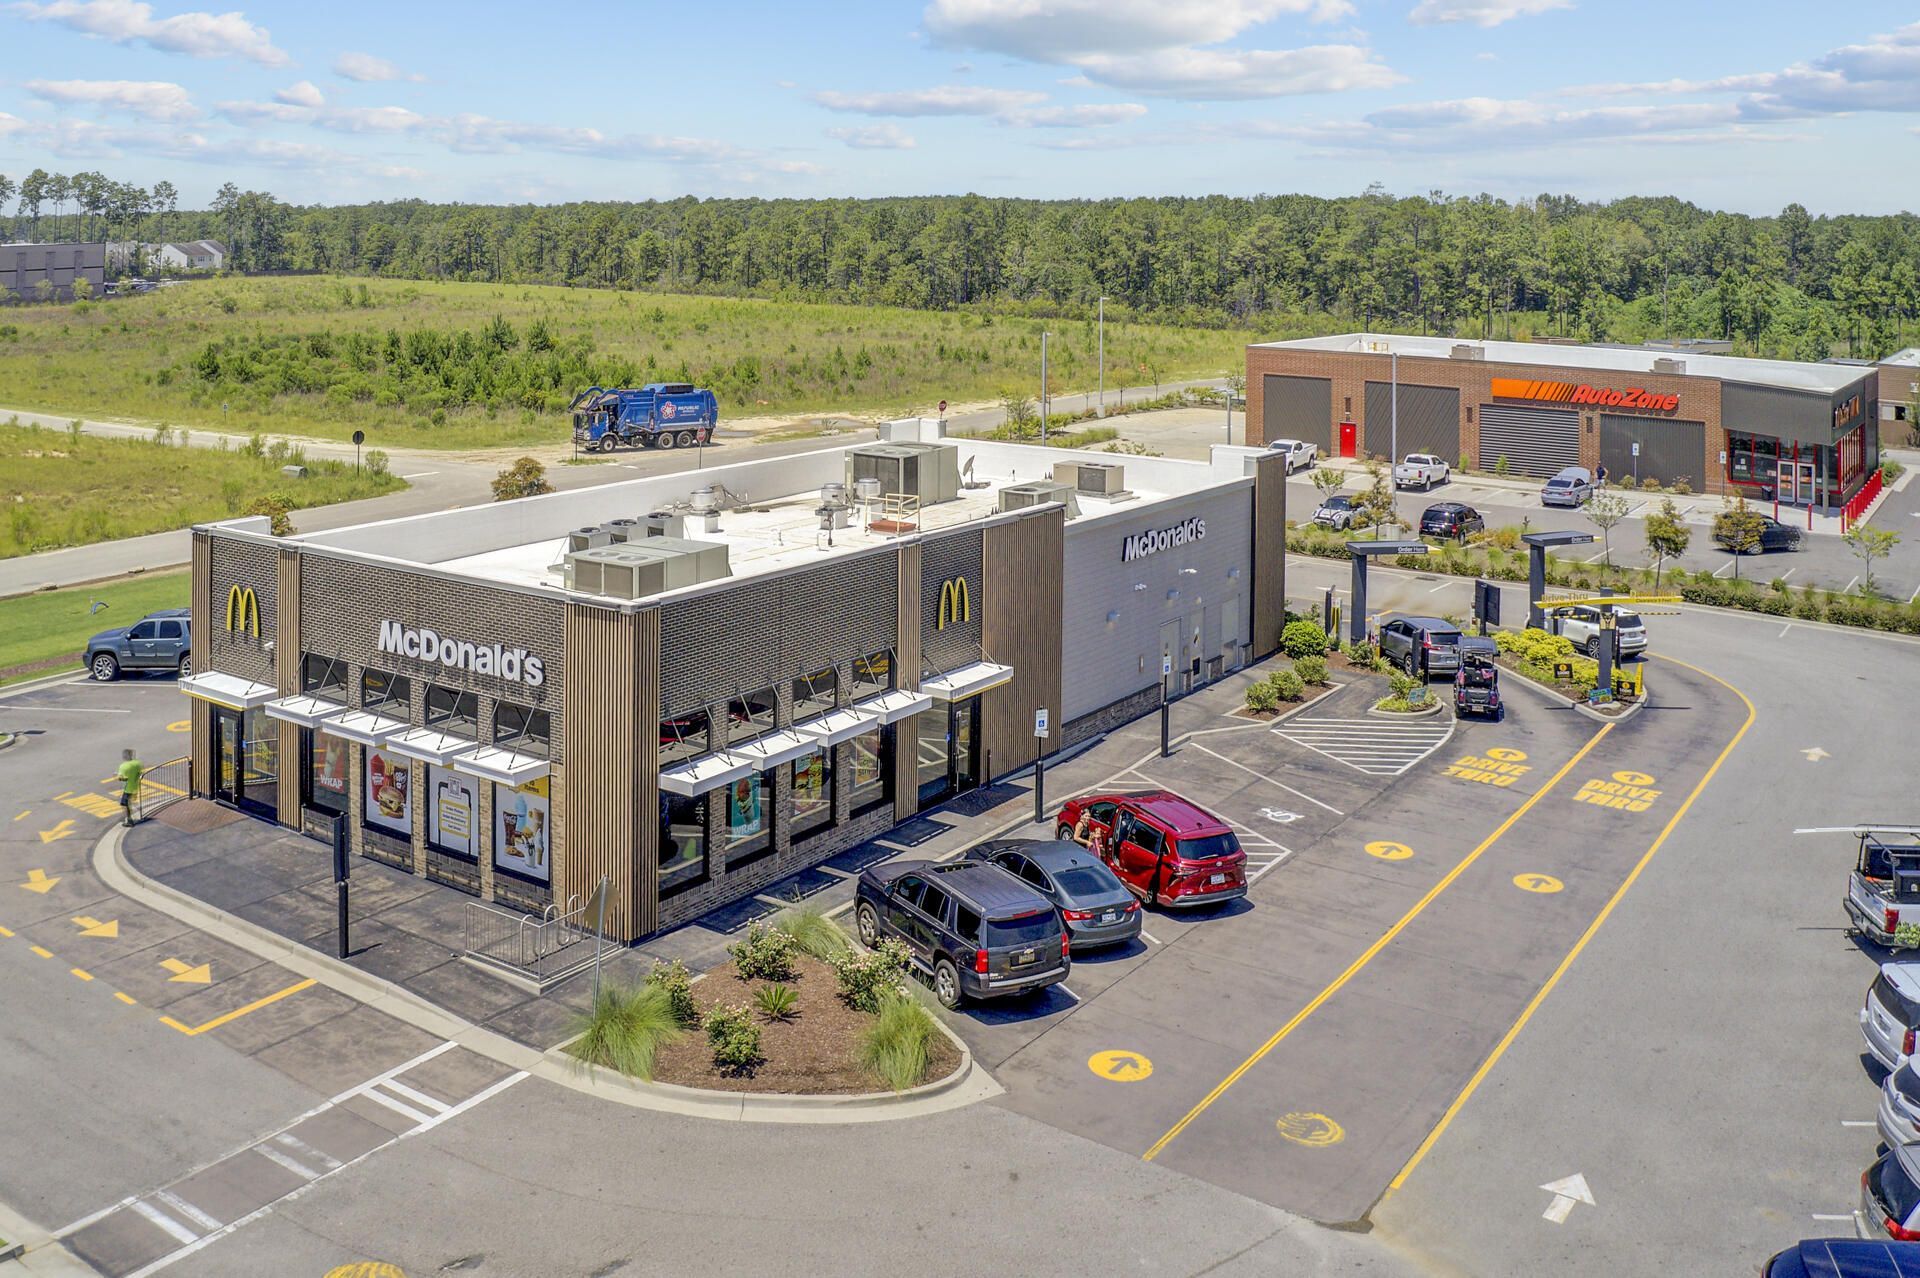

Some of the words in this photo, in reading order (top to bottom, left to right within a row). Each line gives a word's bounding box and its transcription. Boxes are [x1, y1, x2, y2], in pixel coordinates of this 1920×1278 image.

[1570, 383, 1680, 411] AutoZone
[1122, 517, 1206, 562] McDonald's
[378, 620, 545, 686] McDonald's
[1440, 766, 1519, 788] THRU
[1454, 755, 1533, 777] DRIVE
[320, 774, 343, 789] WRAP
[1582, 778, 1663, 800] DRIVE
[1572, 789, 1653, 812] THRU
[732, 820, 759, 835] WRAP
